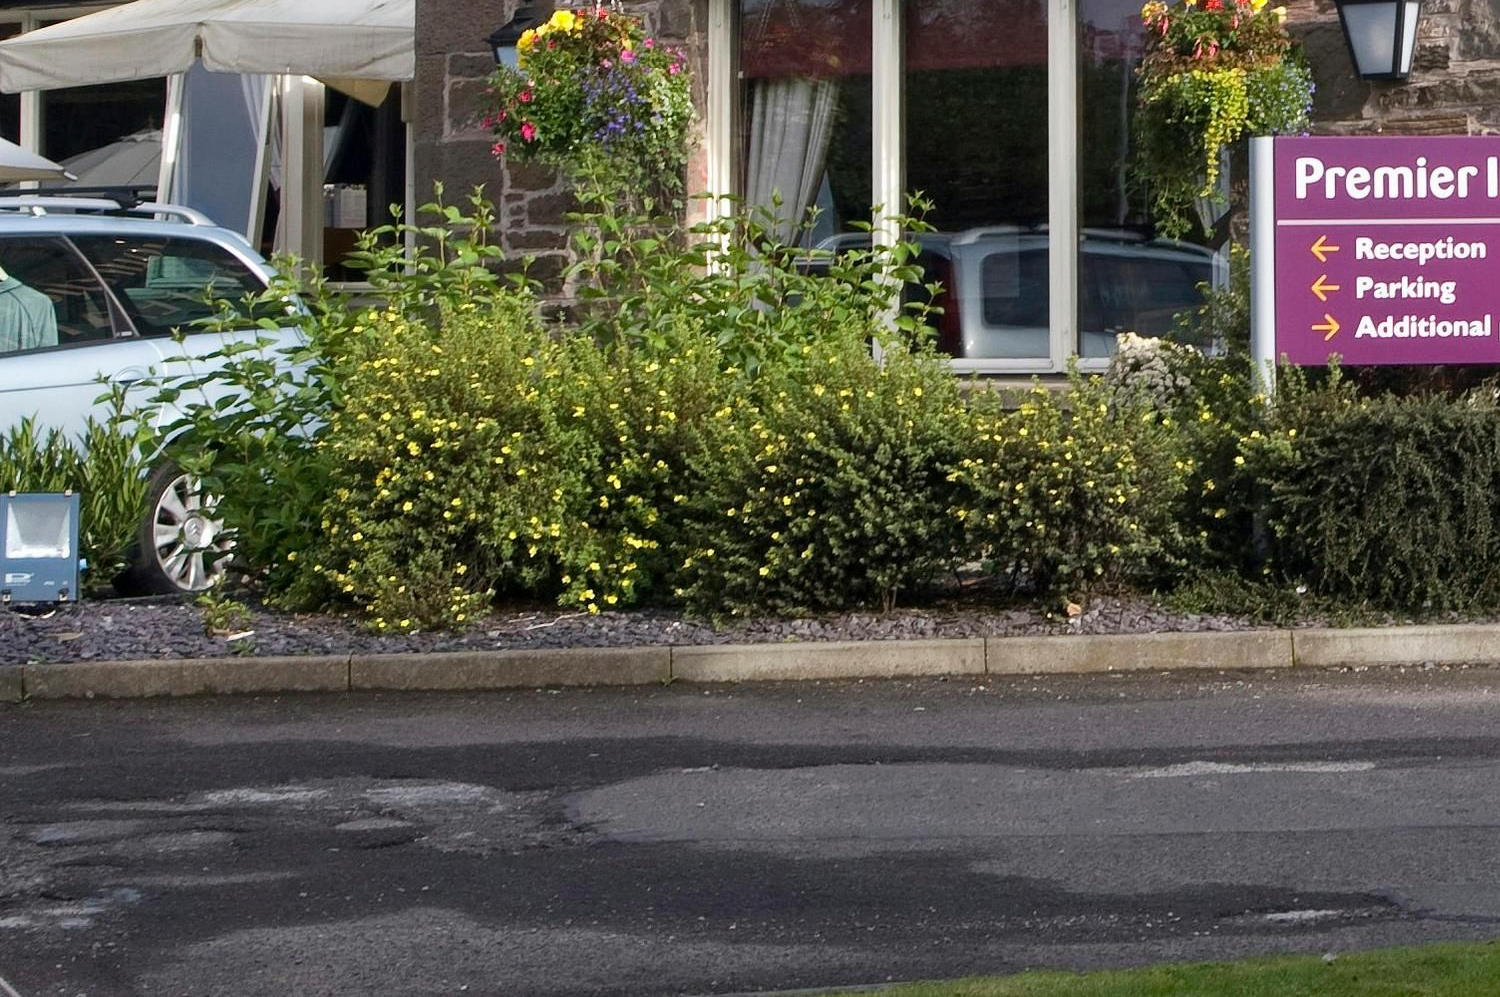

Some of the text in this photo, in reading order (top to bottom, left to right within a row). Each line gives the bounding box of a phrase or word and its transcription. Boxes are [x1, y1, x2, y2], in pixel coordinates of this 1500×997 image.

[1294, 156, 1479, 200] Premier
[1354, 236, 1487, 265] Reception
[1355, 275, 1457, 304] Parking
[1354, 314, 1492, 340] Additional
